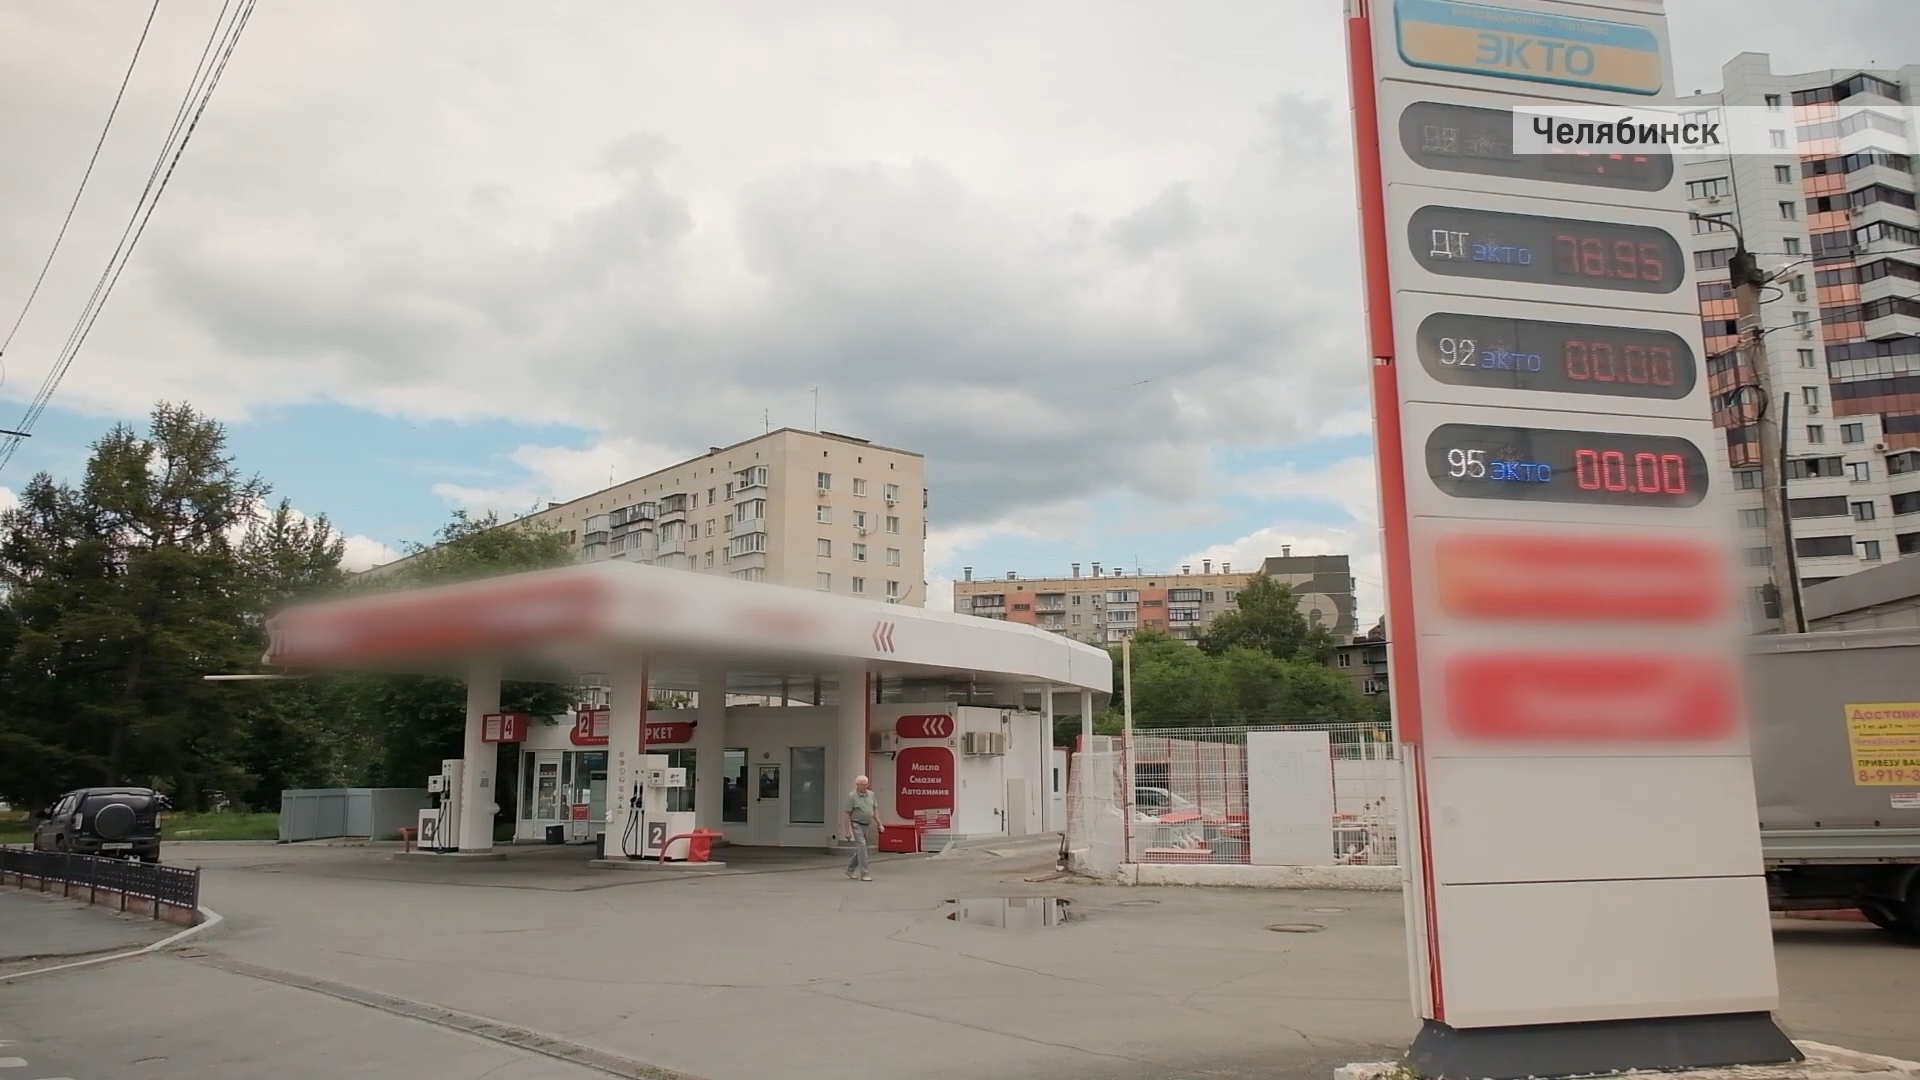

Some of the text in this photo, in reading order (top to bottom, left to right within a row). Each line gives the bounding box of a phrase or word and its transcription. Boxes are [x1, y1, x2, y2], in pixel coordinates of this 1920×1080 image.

[1475, 33, 1595, 76] ЭКТО
[1430, 229, 1469, 258] ДТ
[1471, 243, 1532, 265] ЭКТО
[1439, 337, 1674, 385] 92 ЭКТО 00.00
[1447, 449, 1686, 494] 95 ЭКТО 00.00
[505, 719, 512, 735] 4
[580, 716, 588, 733] 2
[911, 763, 940, 771] Масла
[1858, 759, 1900, 767] ПРИВЕЗУ
[909, 775, 942, 784] Смазки
[901, 787, 949, 796] Автохимия
[424, 822, 432, 838] 4
[652, 827, 662, 843] 2
